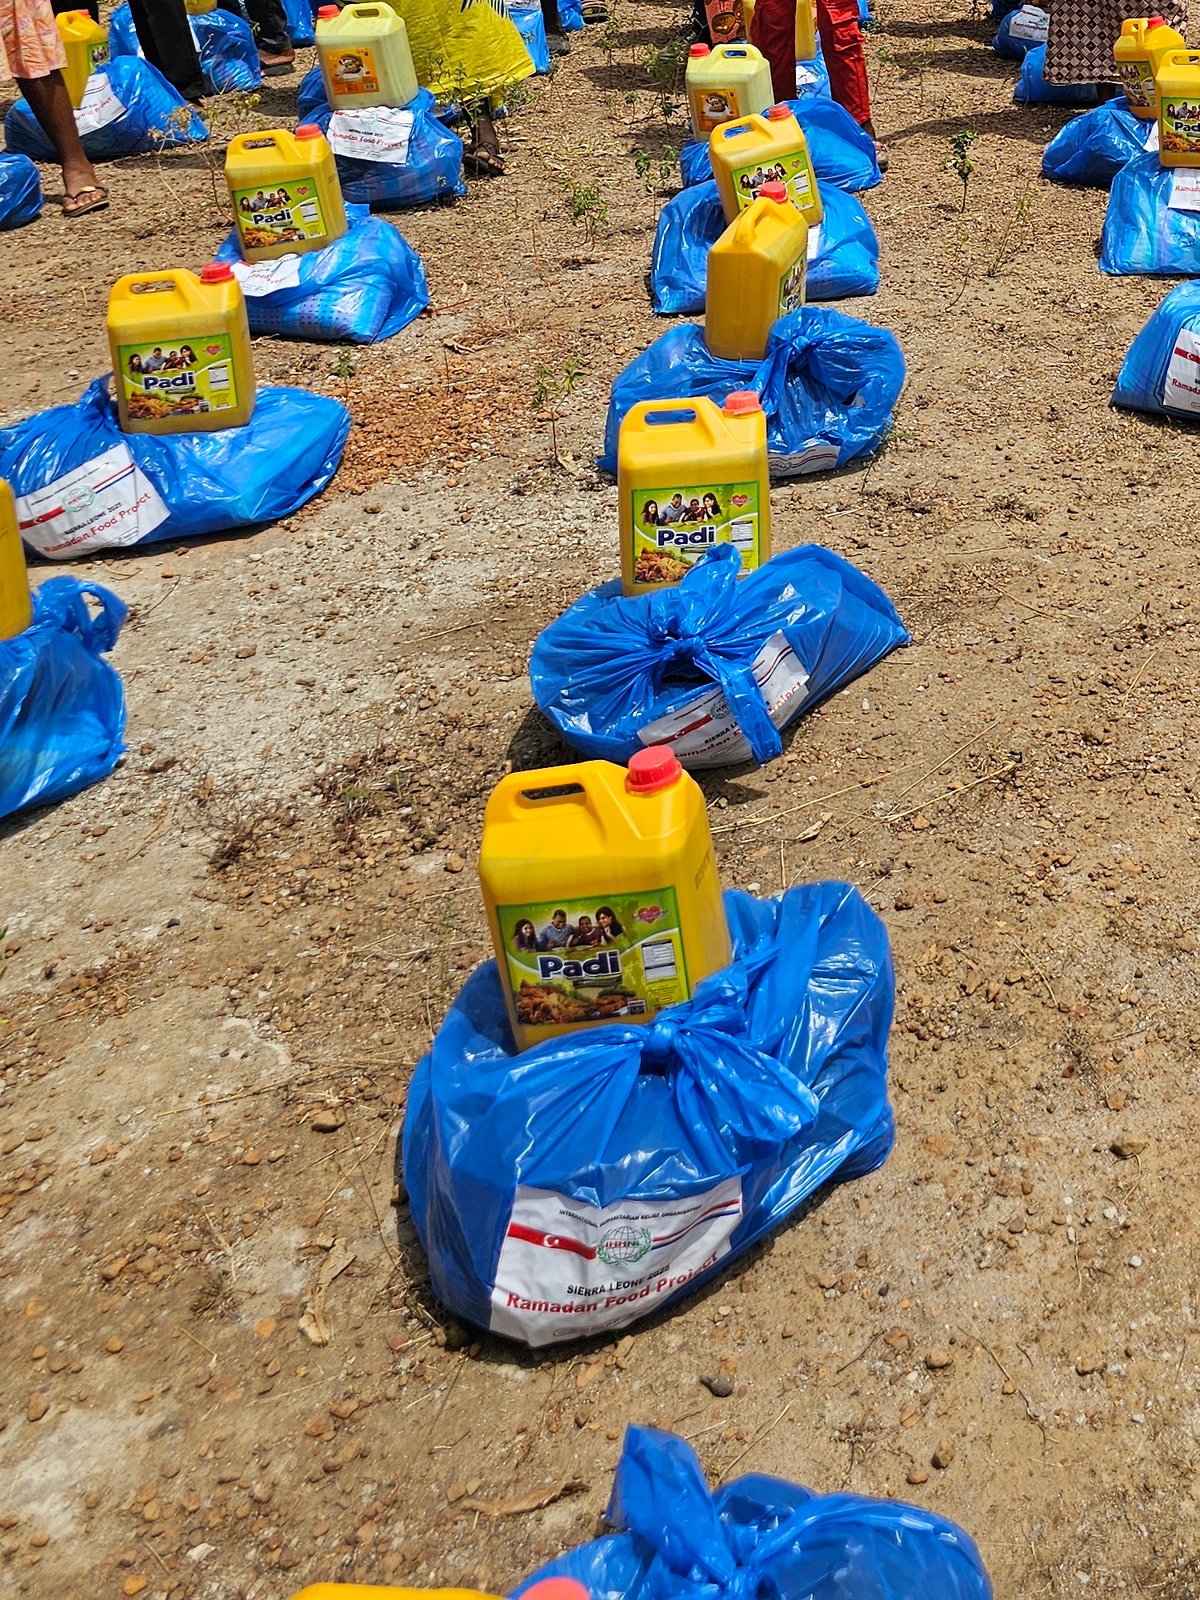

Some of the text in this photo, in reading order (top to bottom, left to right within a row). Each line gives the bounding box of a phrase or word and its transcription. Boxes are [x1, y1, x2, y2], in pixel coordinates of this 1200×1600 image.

[251, 207, 293, 226] Padi
[142, 370, 196, 391] Padi
[44, 532, 90, 553] Ramadan
[90, 516, 118, 536] Food
[656, 525, 717, 548] Padi
[537, 949, 622, 980] Padi
[559, 1209, 598, 1229] INTERNATIONAL
[640, 1212, 661, 1221] RELIEF
[661, 1204, 703, 1218] ORGANISATION
[605, 1240, 643, 1249] IHHNL
[506, 1291, 598, 1314] Ramadan
[604, 1284, 650, 1310] Food
[567, 1284, 606, 1297] SIERRA
[609, 1278, 646, 1292] LEONE
